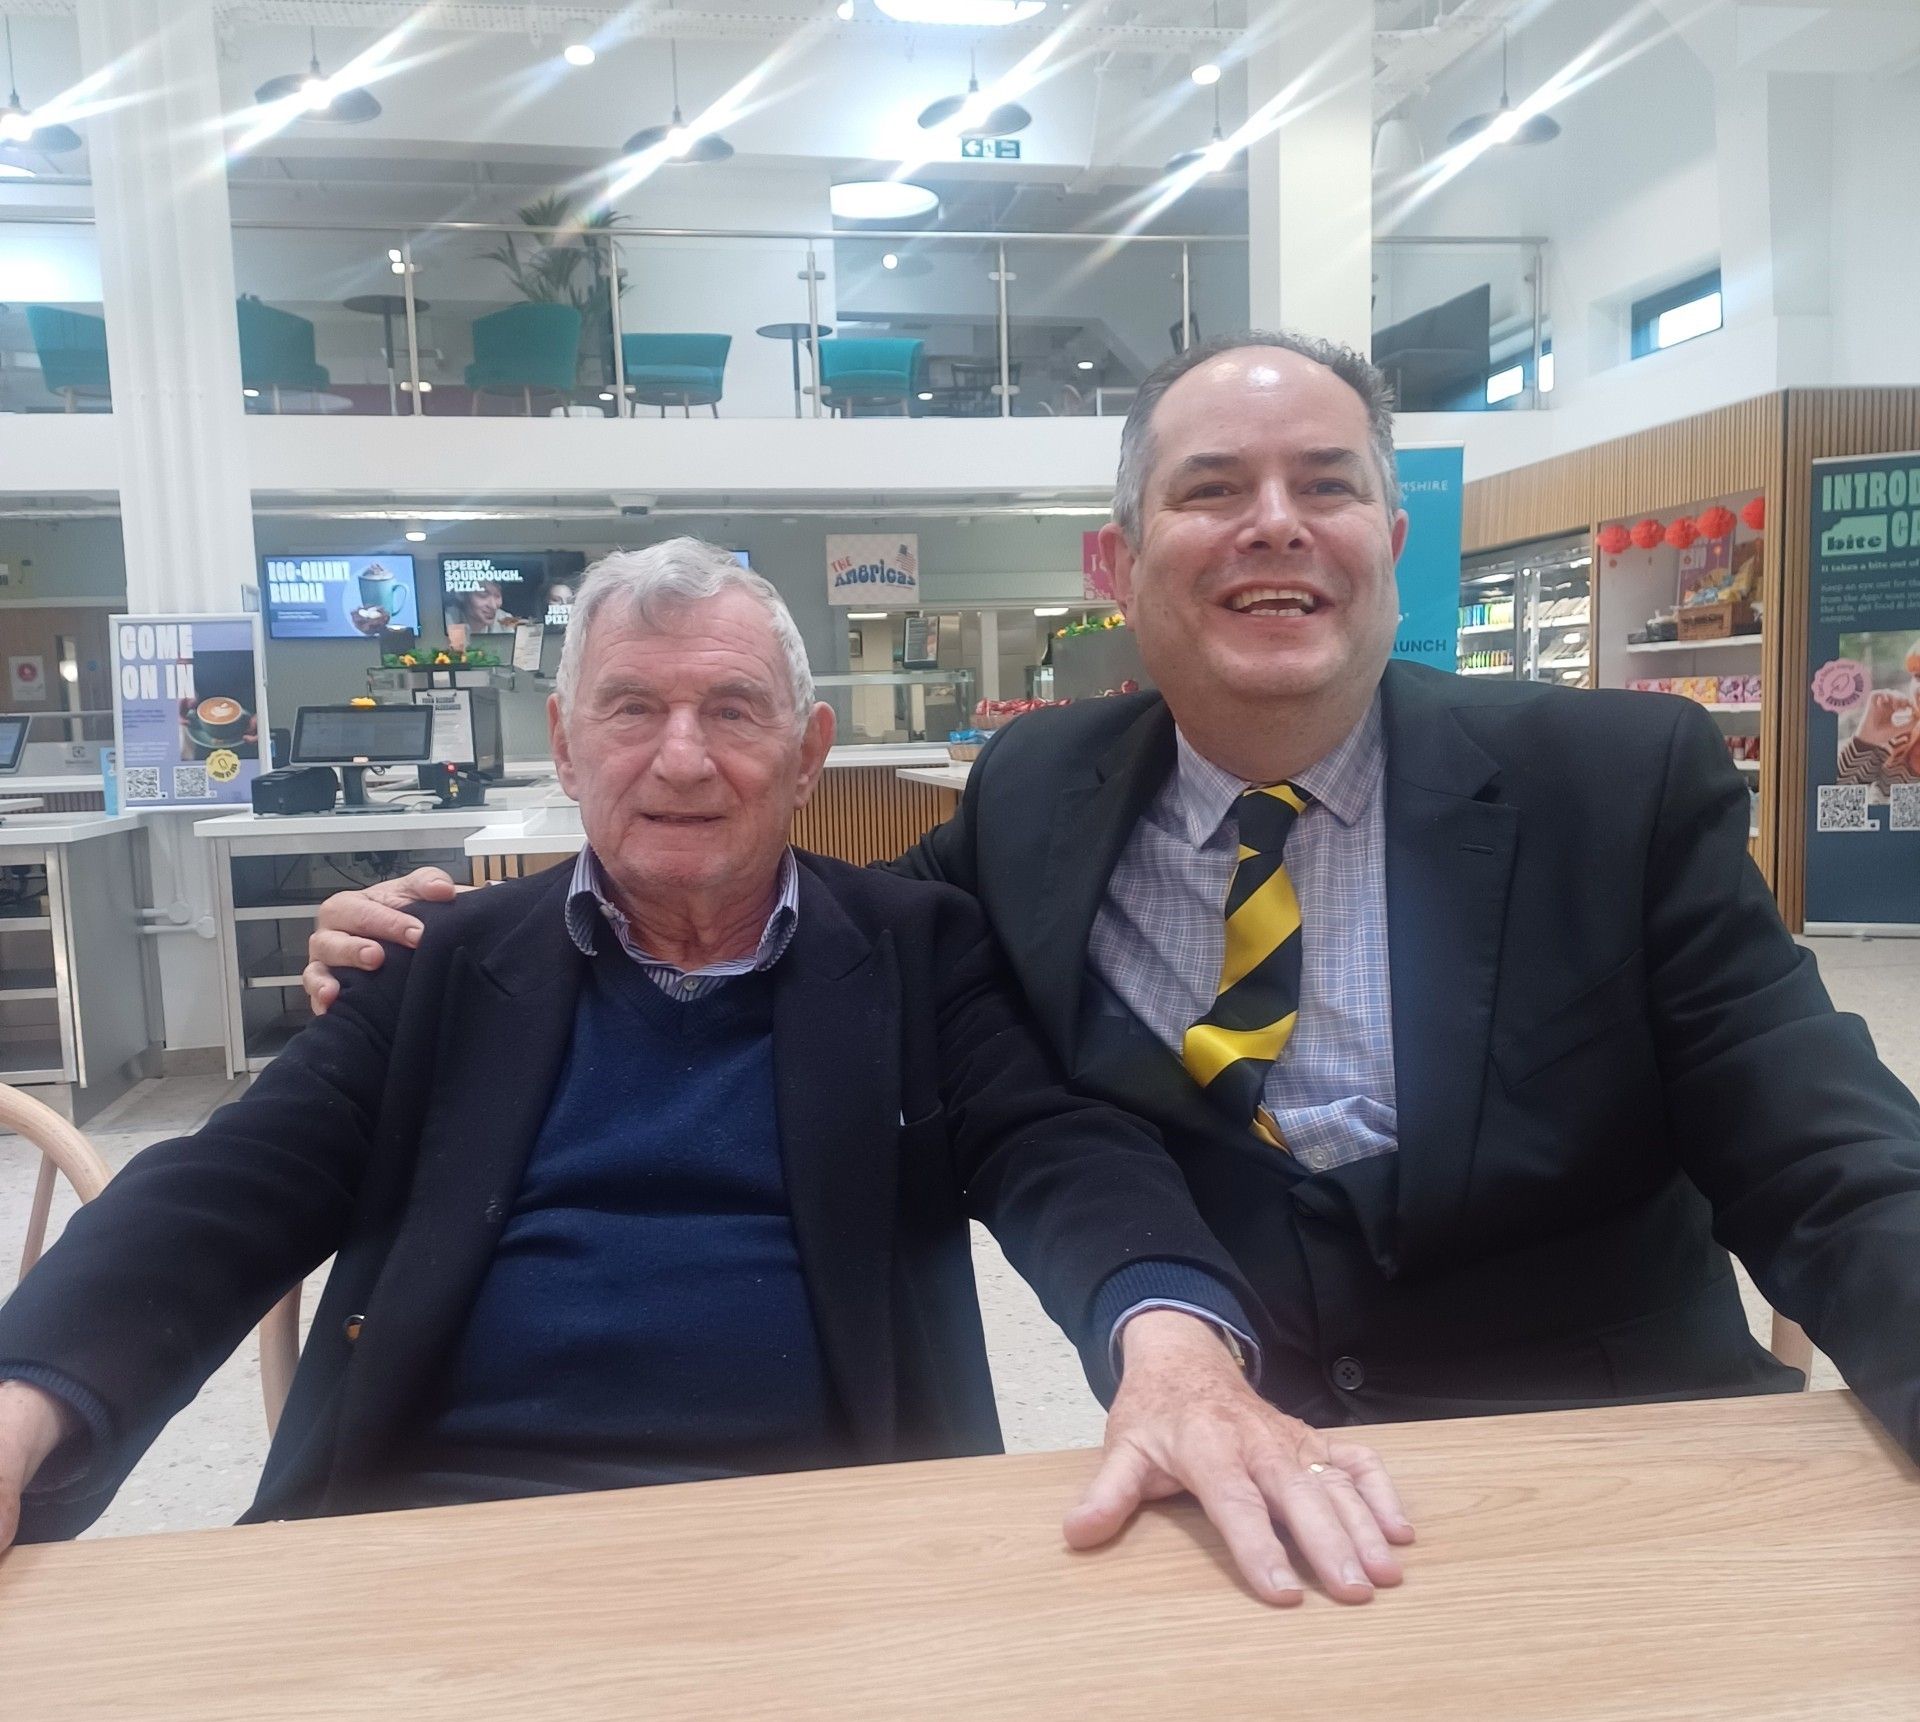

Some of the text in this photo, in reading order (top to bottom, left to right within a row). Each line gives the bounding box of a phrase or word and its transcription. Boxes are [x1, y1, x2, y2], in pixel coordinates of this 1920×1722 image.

[1827, 535, 1882, 550] bite
[443, 560, 495, 571] SPEEDY.
[445, 570, 523, 582] SOURDOUGH.
[446, 580, 485, 592] PIZZA.
[120, 625, 193, 660] COME
[122, 664, 195, 700] ON IN
